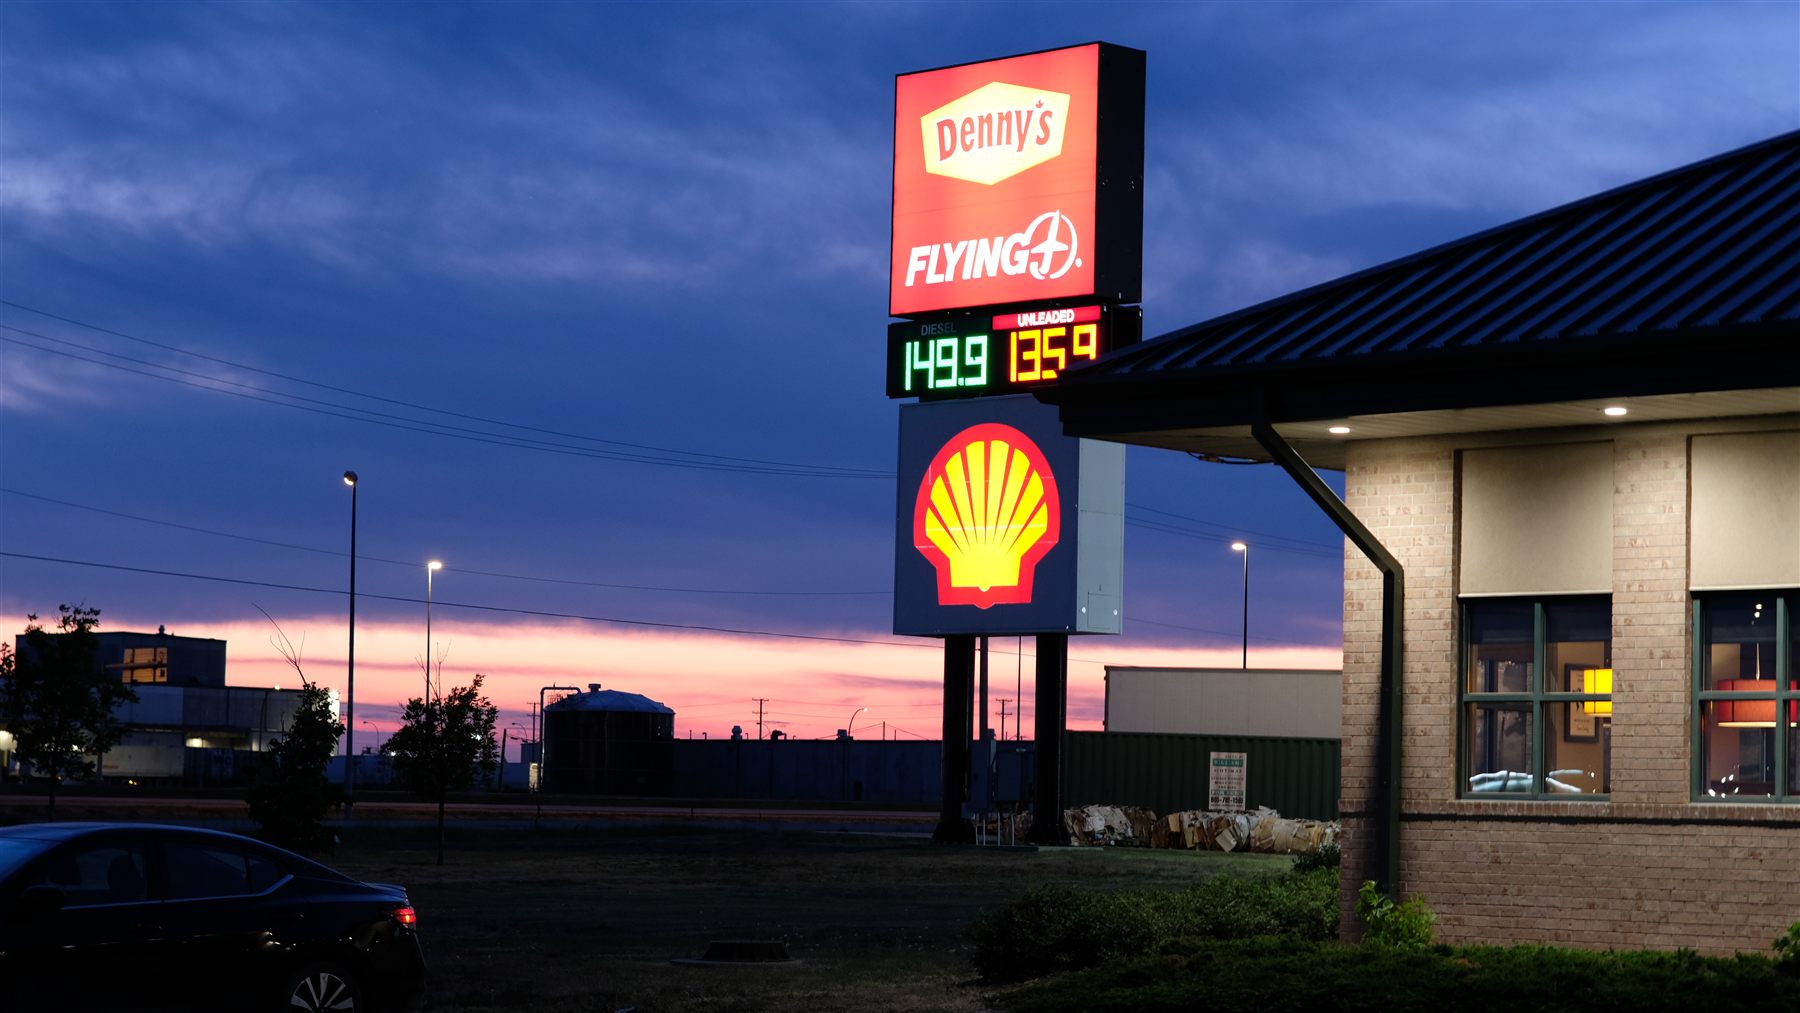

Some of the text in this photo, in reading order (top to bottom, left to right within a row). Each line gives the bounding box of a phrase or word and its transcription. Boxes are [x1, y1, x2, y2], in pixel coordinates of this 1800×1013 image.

[936, 99, 1053, 162] Denny's
[905, 232, 1030, 287] FLYING
[921, 321, 957, 336] DIESEL
[1017, 309, 1075, 327] UNLEADED
[905, 335, 988, 391] 149.9
